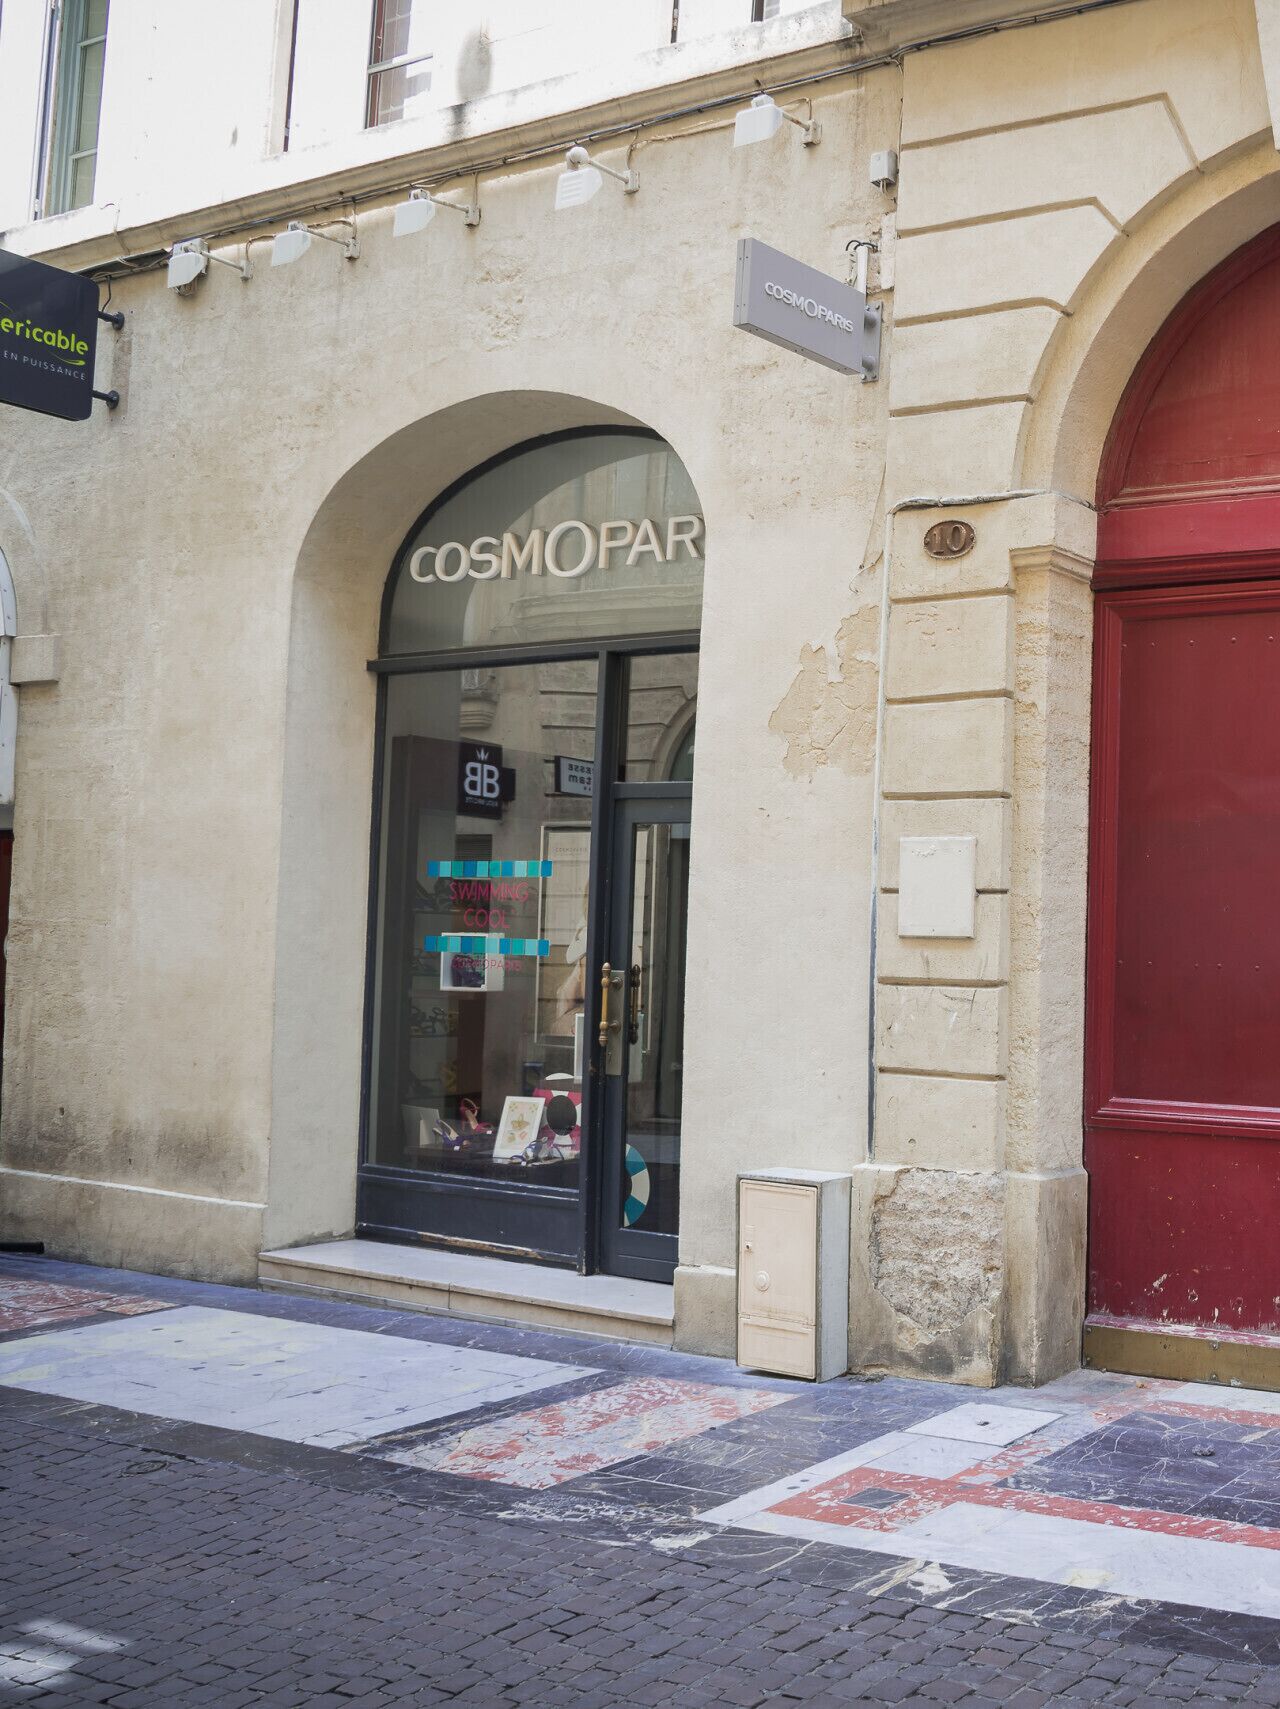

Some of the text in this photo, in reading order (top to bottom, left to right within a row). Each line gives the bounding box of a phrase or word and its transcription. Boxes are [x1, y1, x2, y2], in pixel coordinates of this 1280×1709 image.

[765, 282, 854, 332] COSMOPARIS
[4, 350, 86, 381] EN PUISSANCE
[932, 524, 967, 556] 10
[449, 880, 529, 903] SWIMMING
